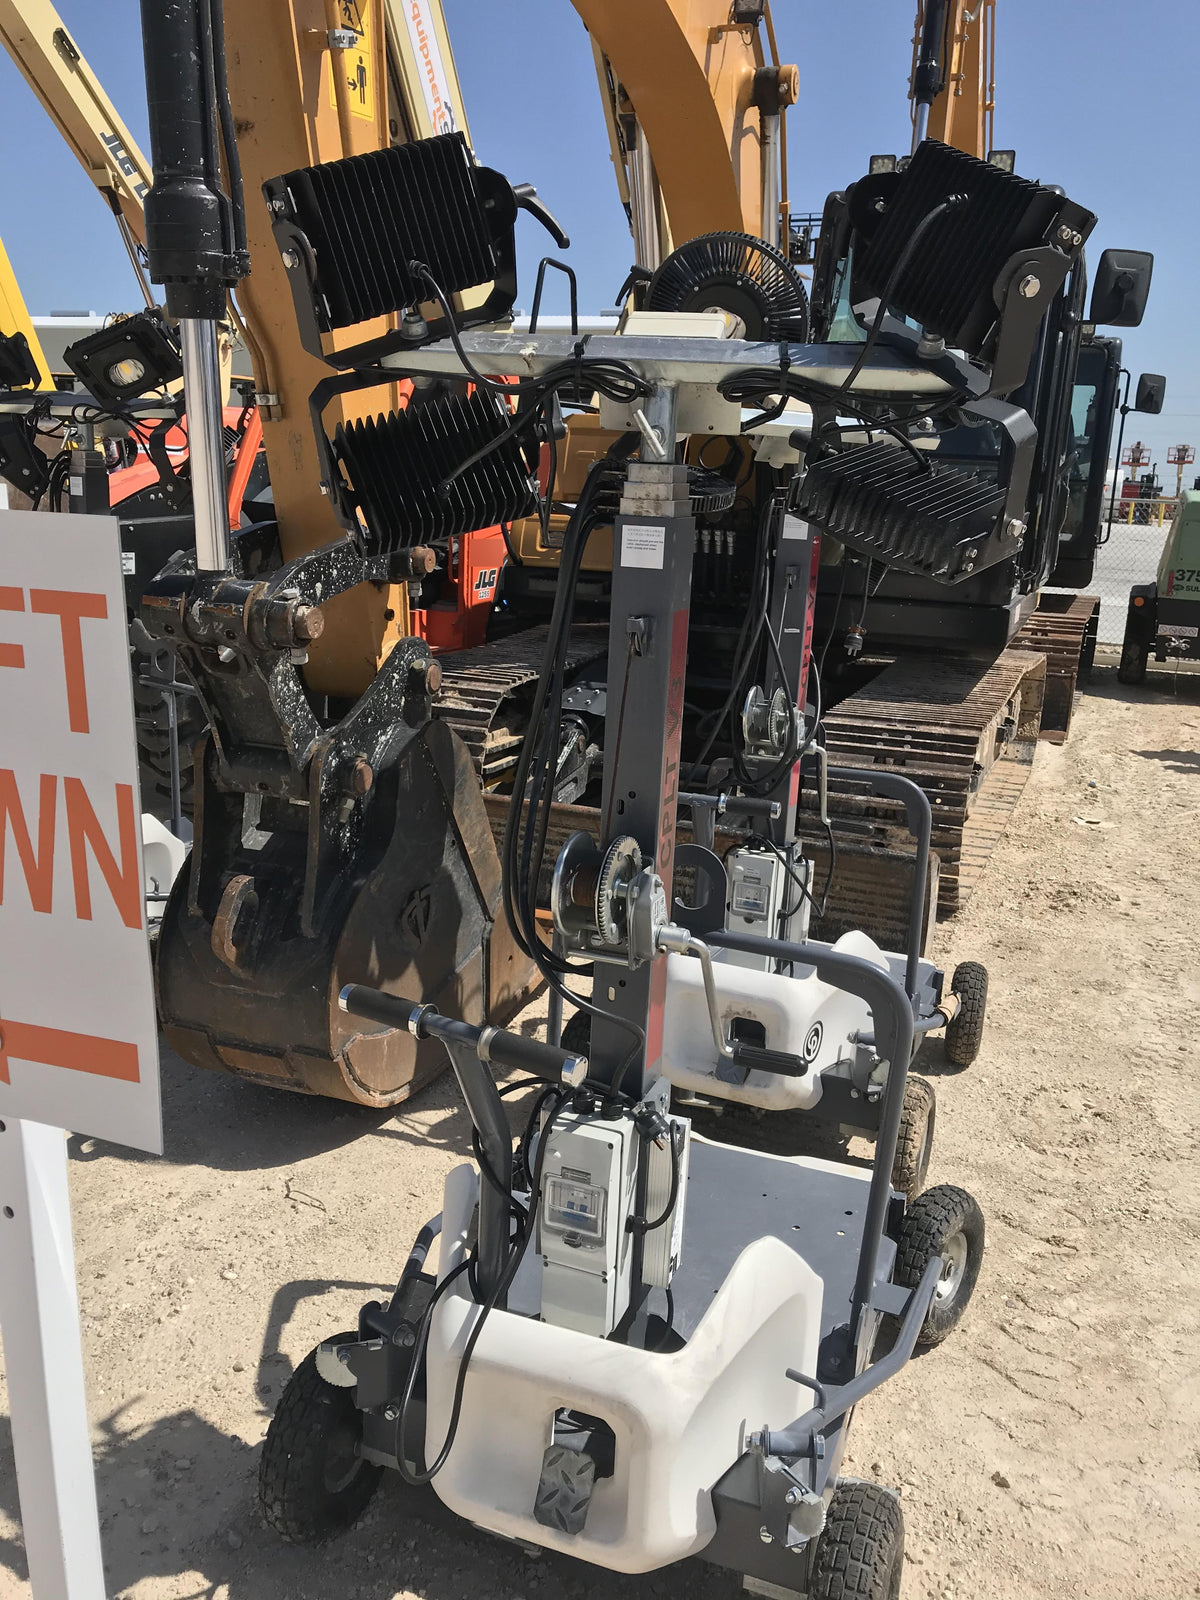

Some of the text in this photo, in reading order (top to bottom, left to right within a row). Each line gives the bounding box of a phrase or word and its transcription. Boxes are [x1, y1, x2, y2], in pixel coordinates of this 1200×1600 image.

[409, 0, 445, 121] quipment
[100, 132, 138, 177] JLG
[474, 568, 498, 590] JLG
[659, 676, 682, 869] CPLT V3
